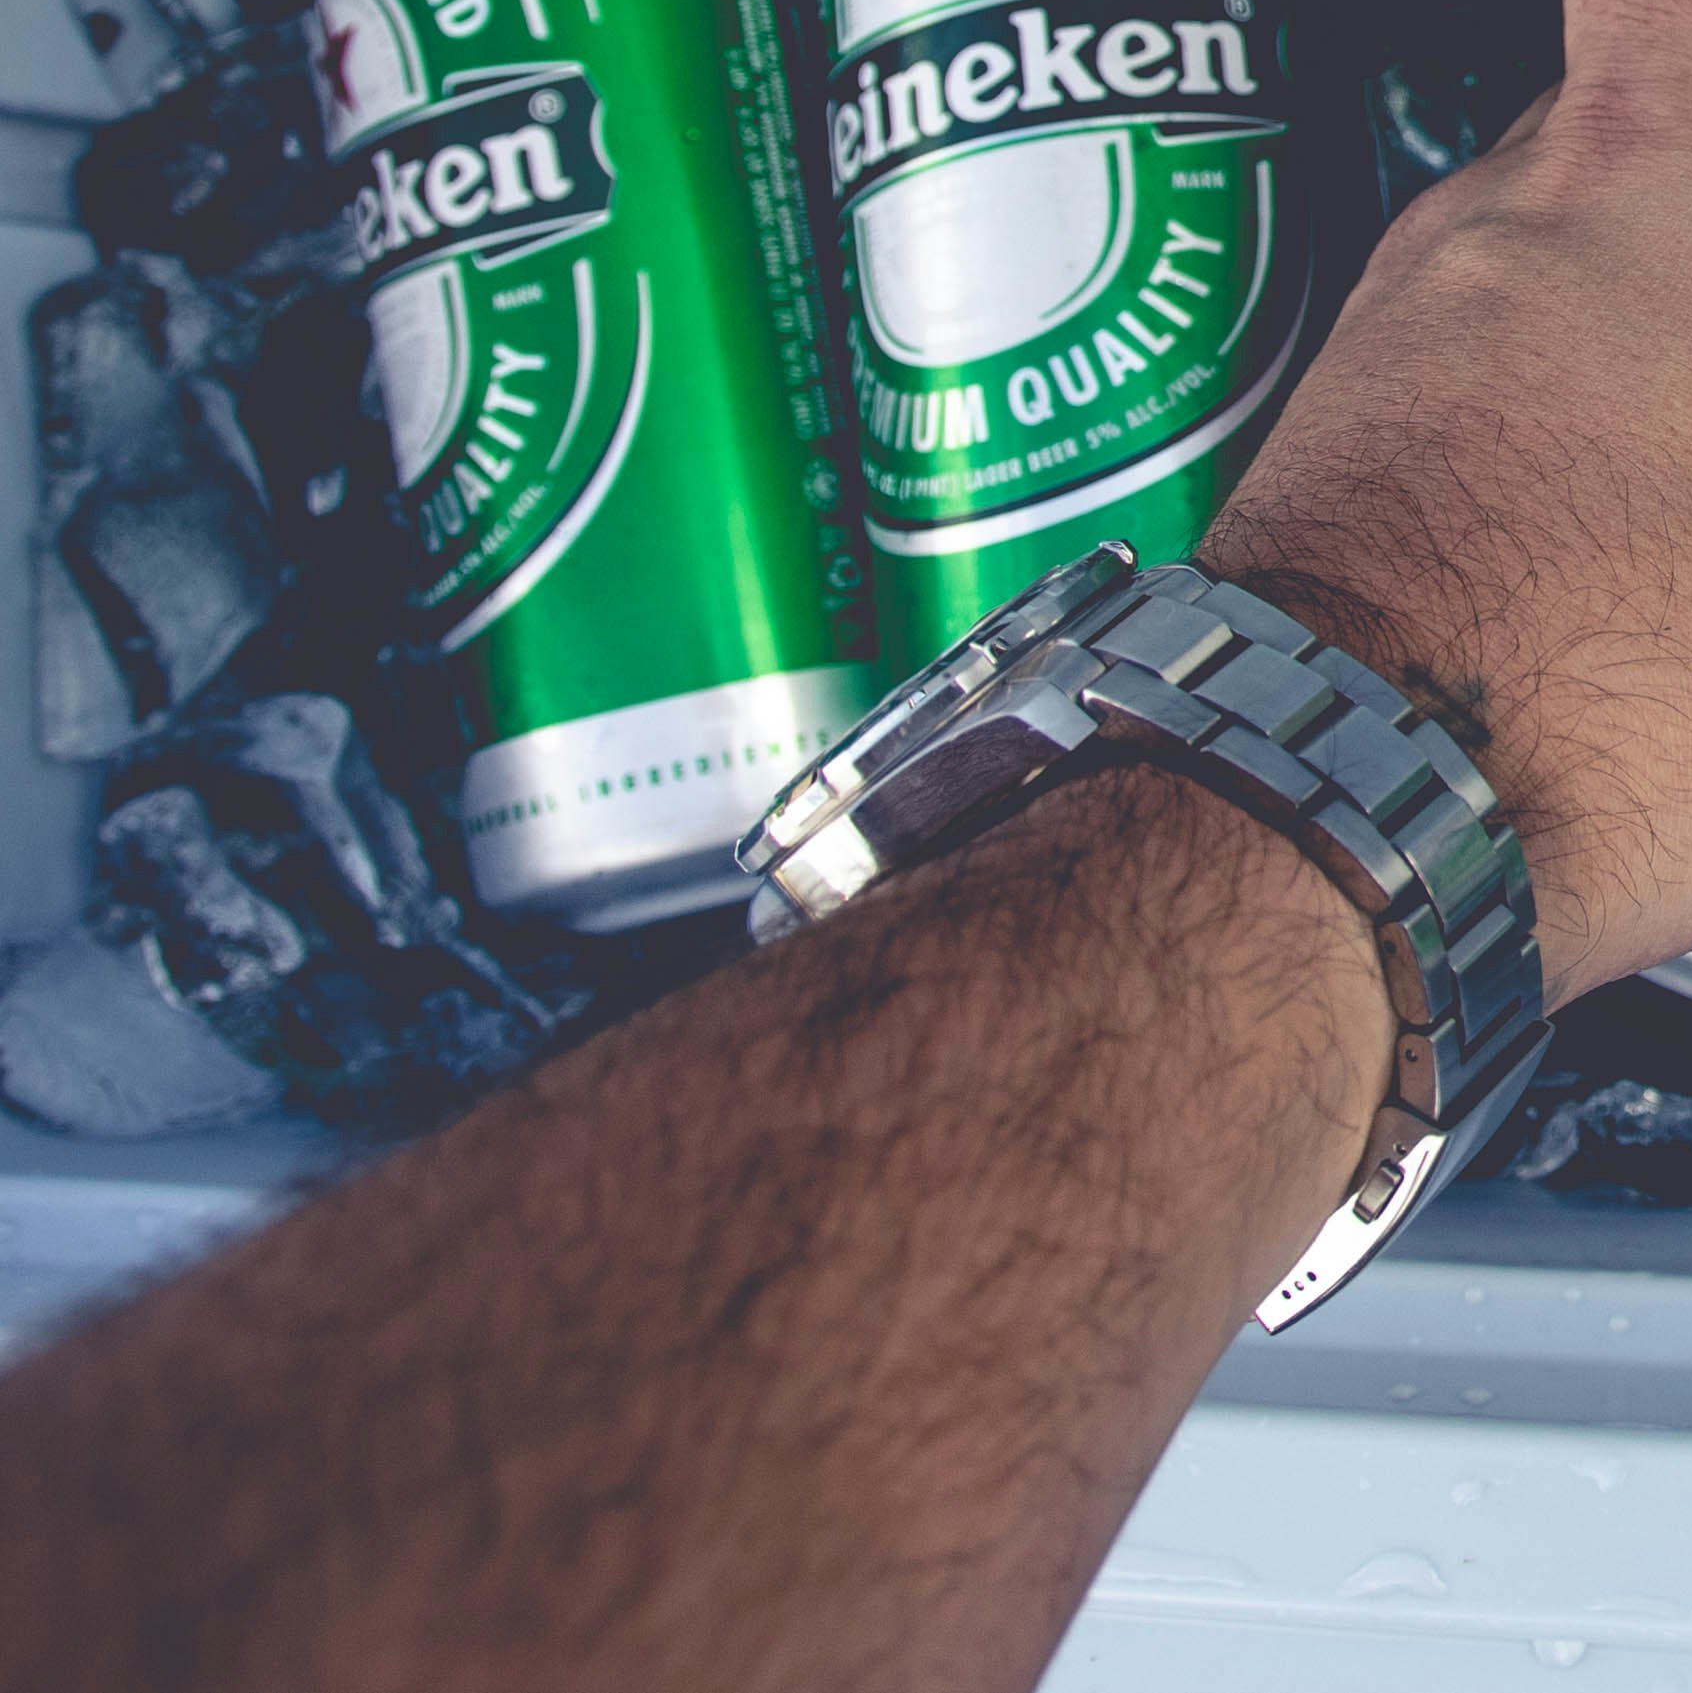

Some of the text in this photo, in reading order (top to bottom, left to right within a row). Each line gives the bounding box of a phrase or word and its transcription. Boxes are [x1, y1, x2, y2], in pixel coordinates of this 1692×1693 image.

[1007, 219, 1225, 426] QUALITY
[1027, 437, 1079, 473] BEER
[1085, 421, 1123, 451] 5%
